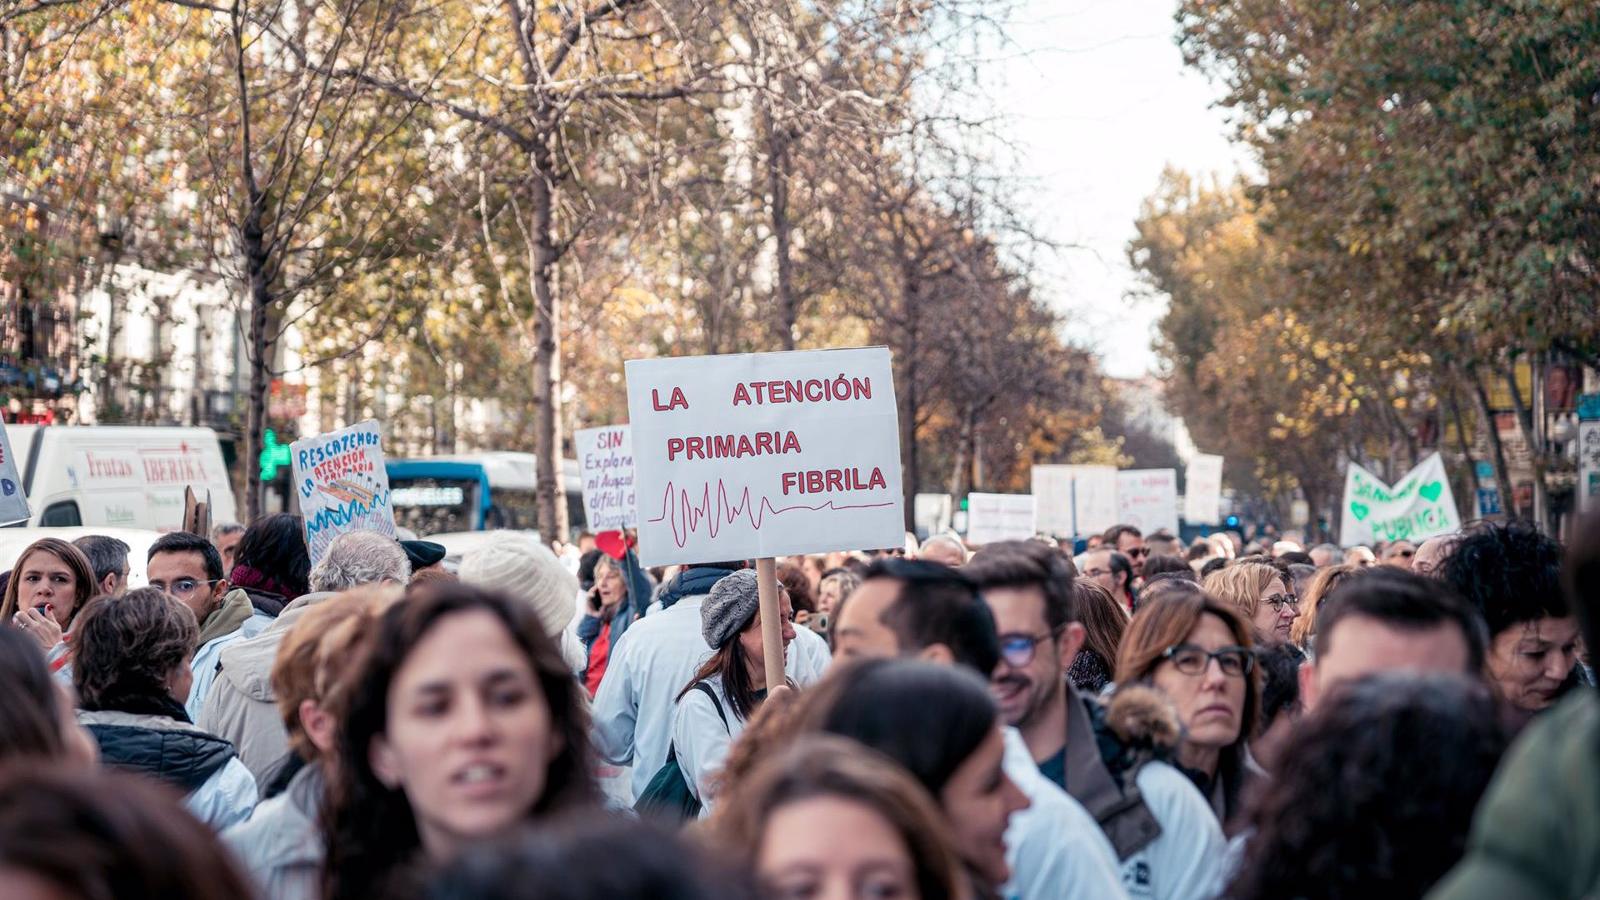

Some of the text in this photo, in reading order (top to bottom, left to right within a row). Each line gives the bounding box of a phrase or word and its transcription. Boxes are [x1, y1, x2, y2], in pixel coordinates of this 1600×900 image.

[651, 373, 872, 412] LA ATENCIÓN
[299, 432, 379, 472] RESCATEMOS
[597, 431, 624, 450] SIN
[667, 430, 801, 461] PRIMARIA
[84, 449, 133, 478] Frutas
[142, 457, 208, 482] IBERIKA
[301, 478, 314, 498] LA
[587, 475, 600, 490] ni
[781, 467, 887, 495] FIBRILA
